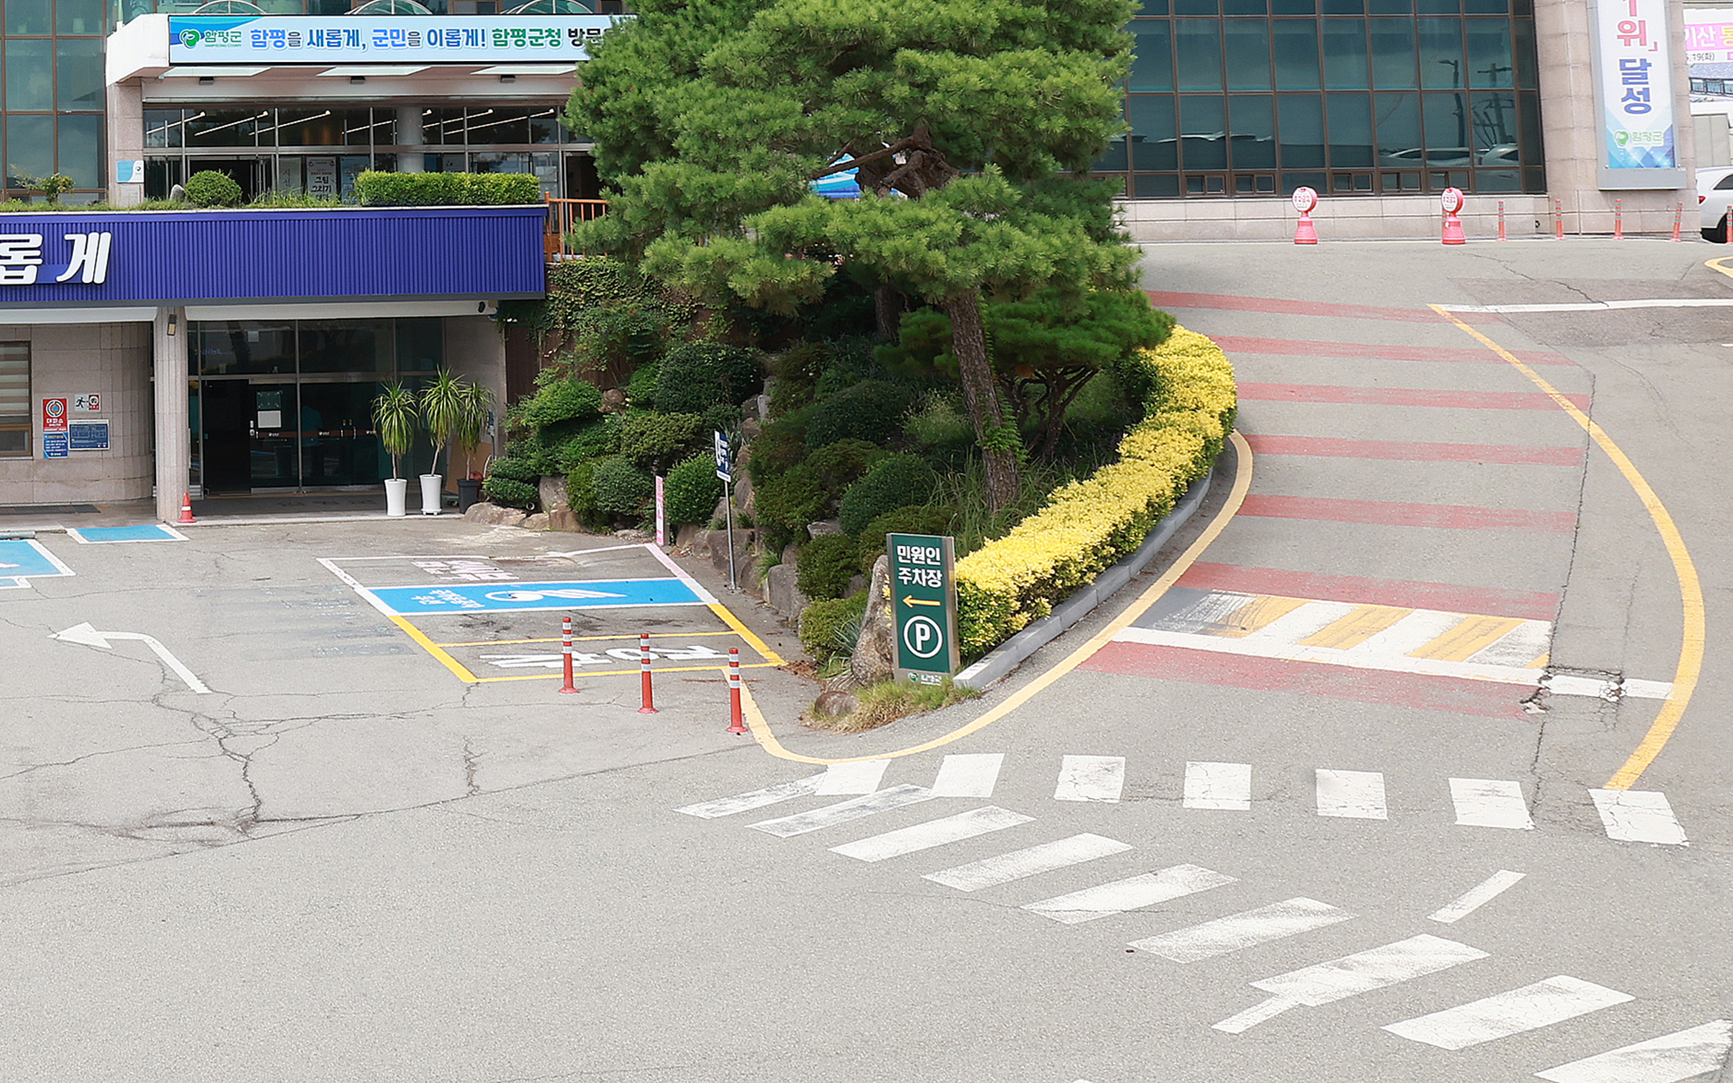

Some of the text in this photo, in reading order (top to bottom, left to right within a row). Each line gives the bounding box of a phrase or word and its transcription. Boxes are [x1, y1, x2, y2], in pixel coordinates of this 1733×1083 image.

[204, 27, 613, 50] 함평군 함평을 새롭게, 군민을 이롭게! 함평군청 방문
[1618, 57, 1653, 116] 달성
[1632, 131, 1663, 142] 함평군
[896, 544, 942, 566] 민원인
[897, 567, 943, 589] 주차장
[915, 623, 932, 651] P
